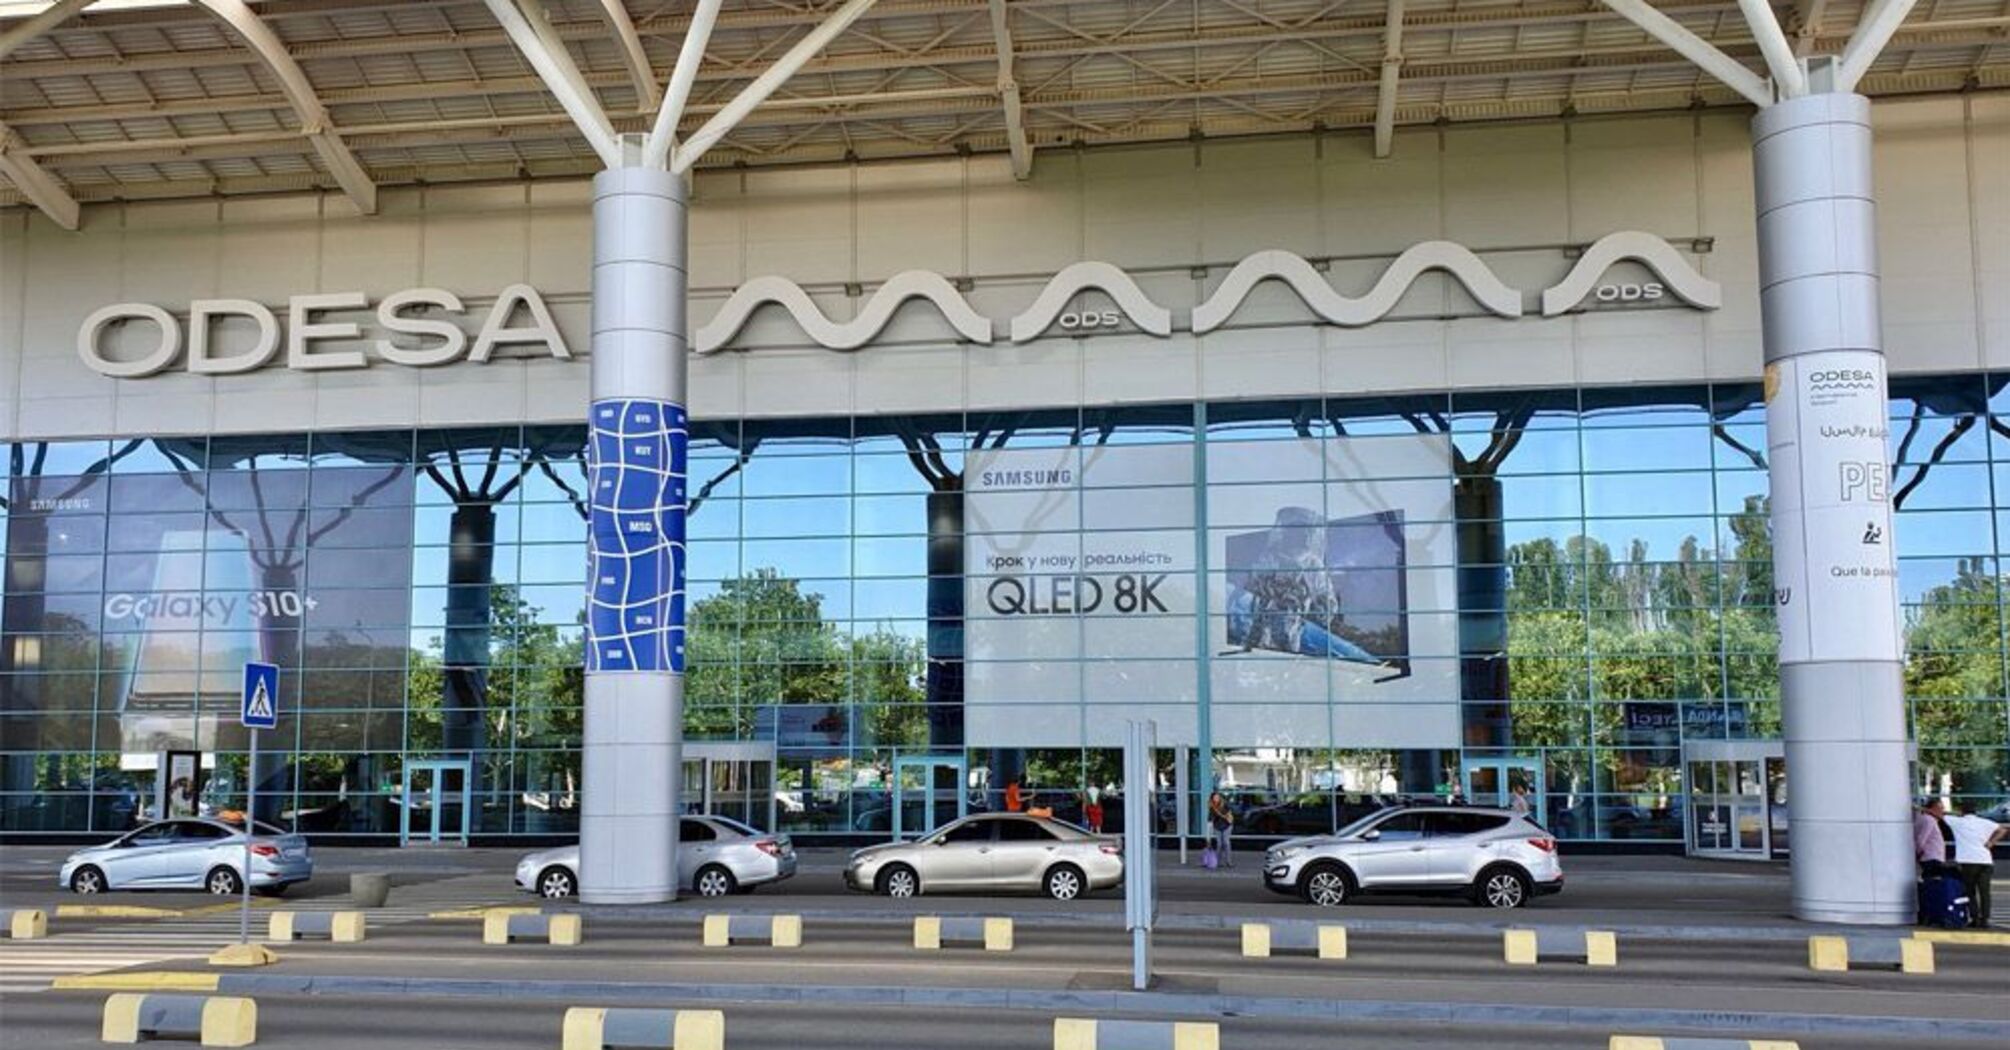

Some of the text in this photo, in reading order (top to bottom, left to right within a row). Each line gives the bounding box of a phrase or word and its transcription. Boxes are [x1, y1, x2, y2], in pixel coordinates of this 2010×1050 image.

[1596, 283, 1664, 301] ODS
[1060, 311, 1121, 328] ODS
[78, 283, 573, 378] ODESA
[1810, 370, 1874, 383] ODESA
[983, 470, 1072, 486] SAMSUNG
[30, 498, 91, 511] SAMSUNG
[1028, 556, 1036, 570] у
[1040, 555, 1077, 569] нову
[1084, 551, 1172, 569] реальність
[1831, 566, 1857, 577] Que
[1861, 566, 1871, 576] la
[987, 575, 1168, 615] QLED 8K
[105, 591, 318, 624] Galaxy S10+
